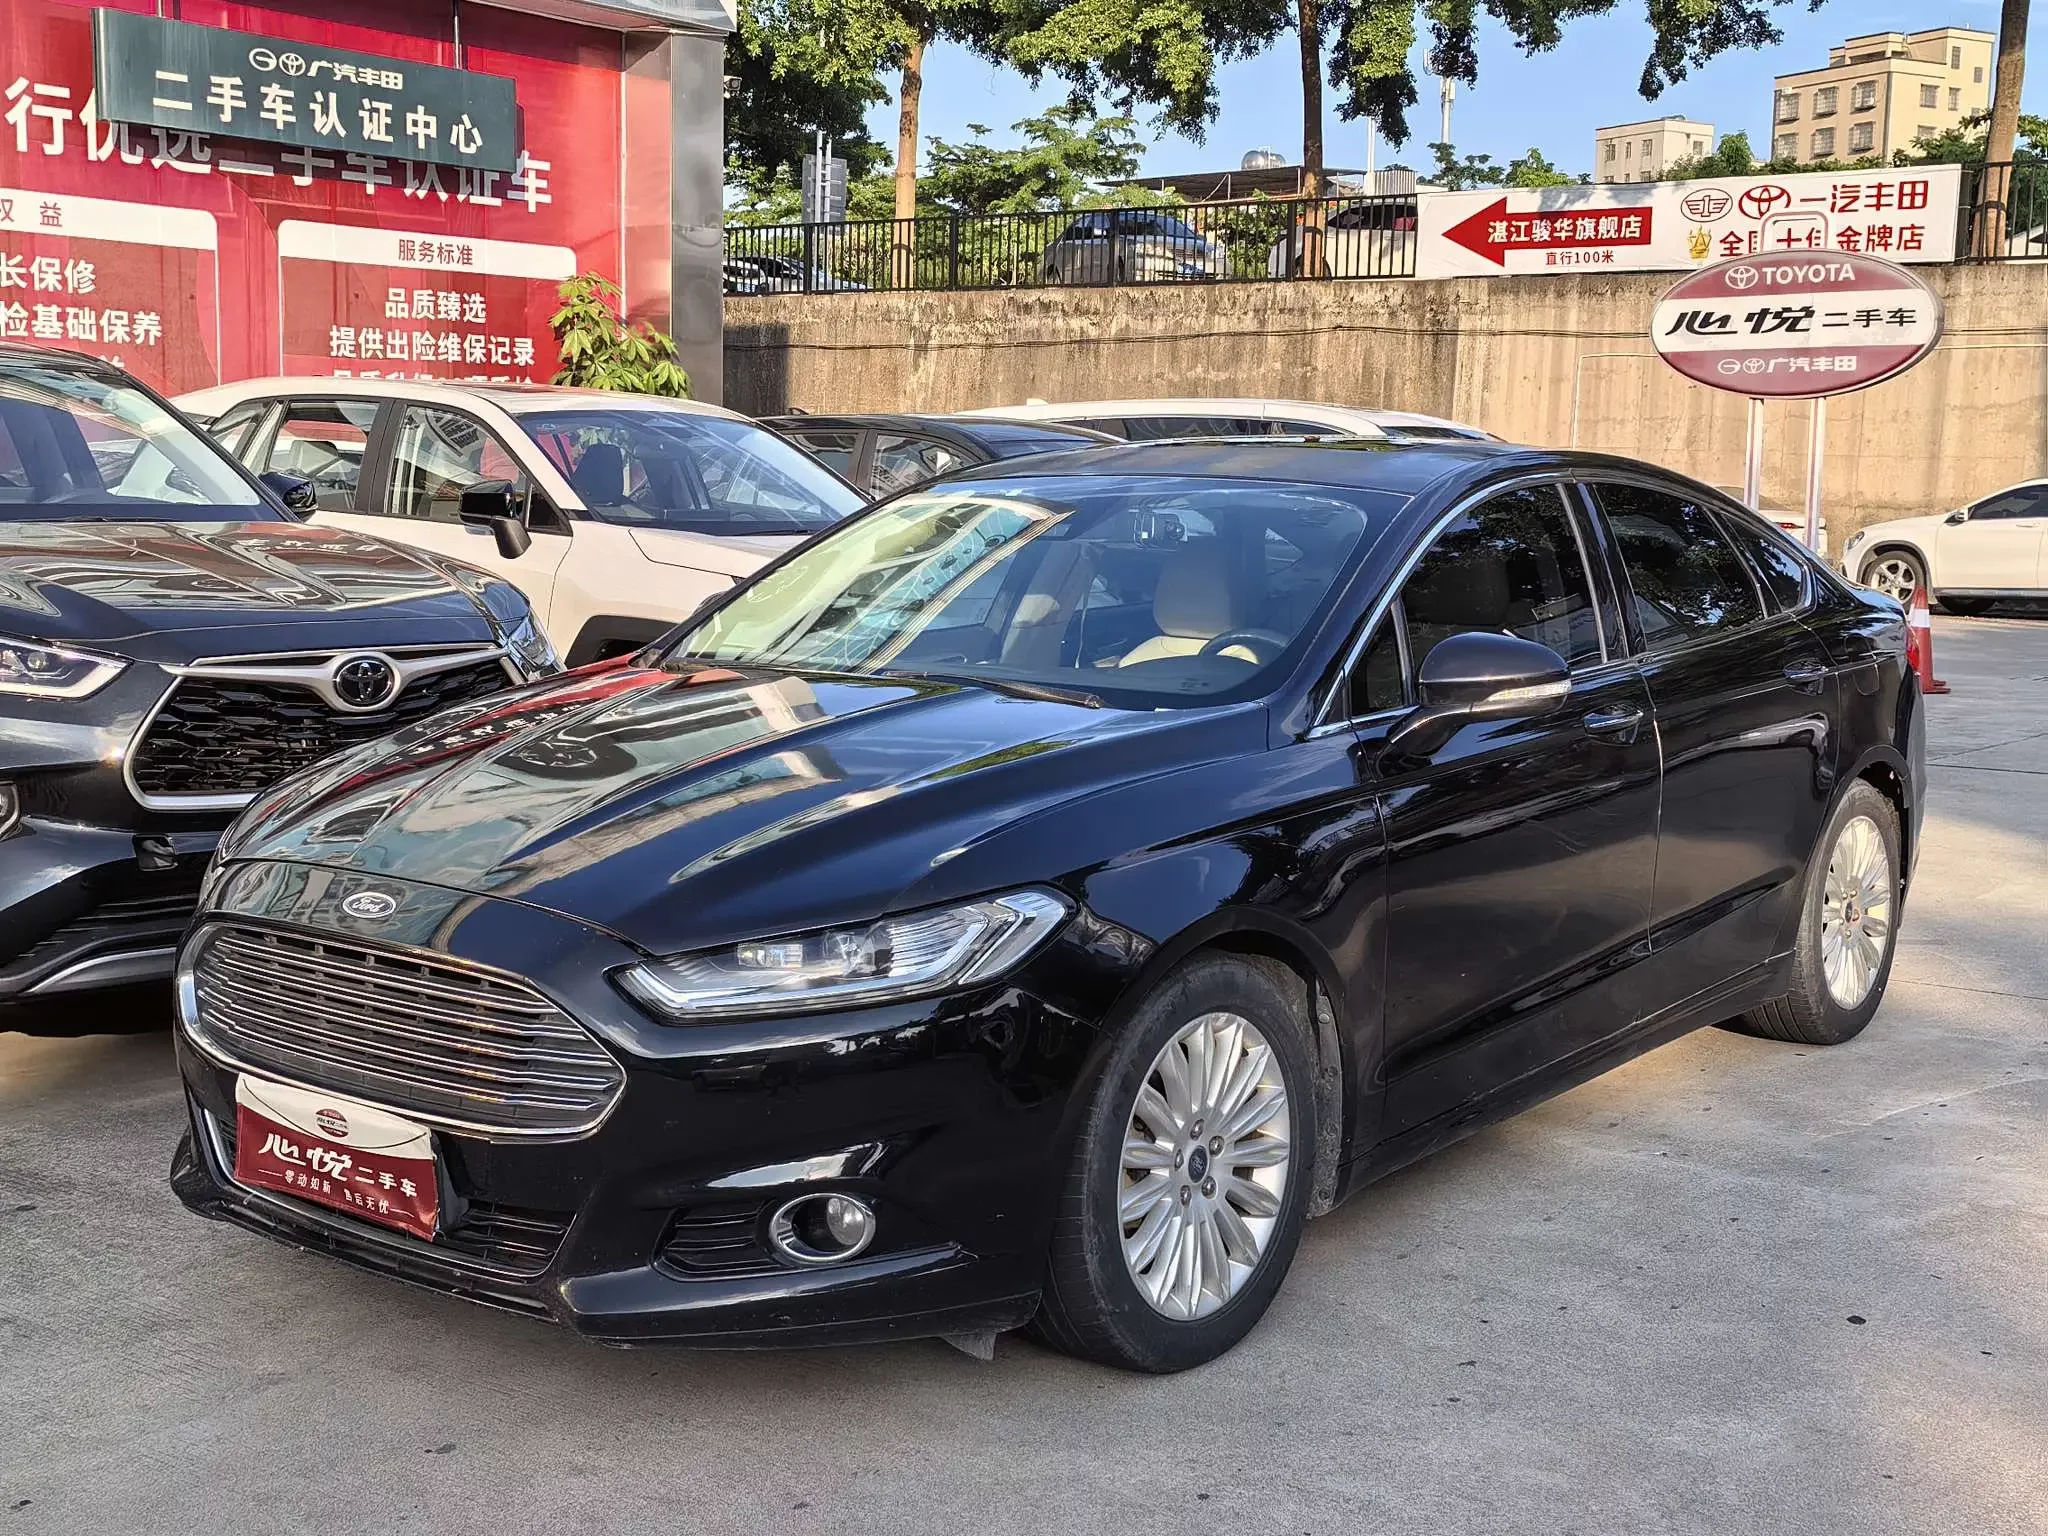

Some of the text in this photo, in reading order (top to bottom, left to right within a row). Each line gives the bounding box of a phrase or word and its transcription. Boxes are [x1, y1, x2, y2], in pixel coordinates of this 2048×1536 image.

[307, 60, 404, 90] 广汽丰田
[152, 70, 483, 154] 二手车认证中心
[1799, 180, 1929, 214] 一汽丰田
[1487, 215, 1643, 244] 湛江骏华旗舰店
[398, 239, 473, 266] 服务标准
[1545, 250, 1614, 266] 直行100米
[0, 252, 96, 294] 长保修
[1762, 263, 1856, 286] TOYOTA
[384, 287, 487, 324] 品质臻选
[0, 301, 163, 346] 检基础保养
[329, 324, 535, 367] 提供出险维保记录
[1766, 355, 1857, 374] 广汽丰田
